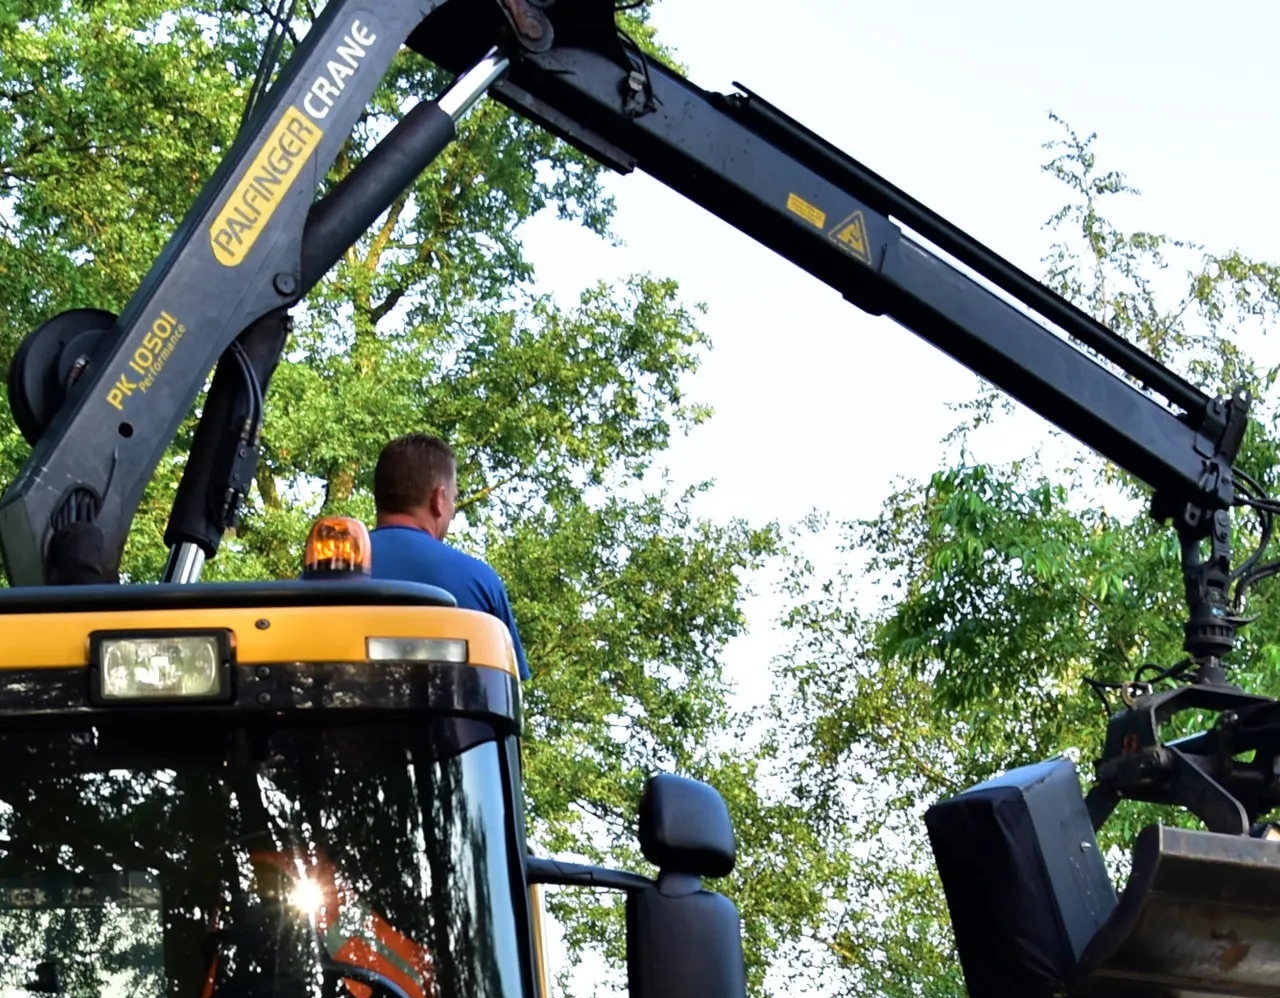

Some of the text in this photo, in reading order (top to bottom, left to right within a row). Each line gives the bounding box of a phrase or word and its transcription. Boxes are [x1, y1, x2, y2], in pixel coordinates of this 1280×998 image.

[213, 19, 377, 257] PALFINGER CRANE
[106, 311, 177, 410] PK 10501
[139, 324, 186, 393] Performance
